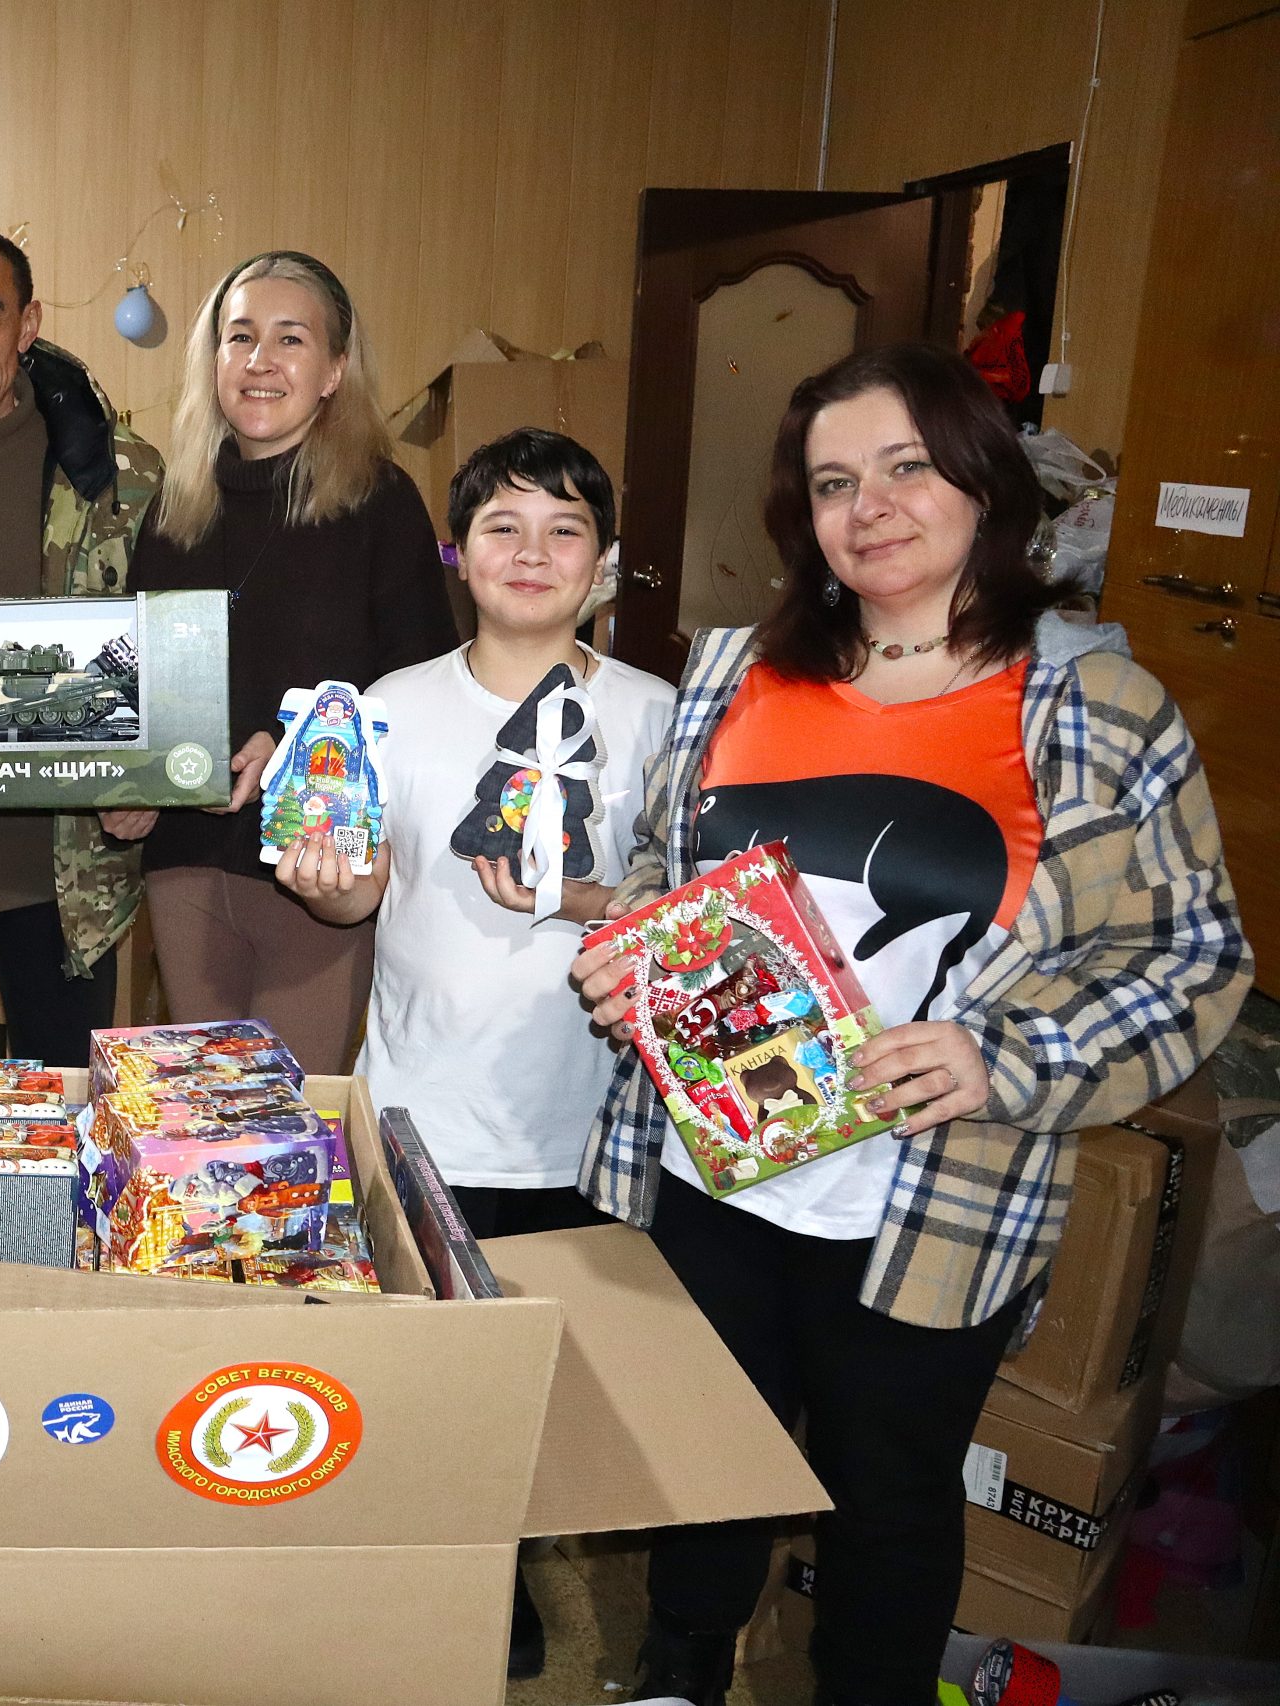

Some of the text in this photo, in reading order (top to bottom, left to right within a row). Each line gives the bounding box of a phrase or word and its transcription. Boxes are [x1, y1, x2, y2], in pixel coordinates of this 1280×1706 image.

[1160, 486, 1245, 522] Медикаменты
[173, 622, 201, 639] 3+
[173, 744, 205, 759] Одобрено
[38, 761, 125, 781] «ЩИТ»
[676, 999, 716, 1036] 35
[729, 1045, 787, 1076] КАНТАТА
[195, 1368, 349, 1413] СОВЕТ ВЕТЕРАНОВ
[60, 1404, 94, 1413] РОССИЯ
[166, 1430, 351, 1501] МИАССКОГО ГОРОДСКОГО ОКРУГА
[986, 1486, 997, 1508] 8743
[1009, 1489, 1025, 1520] ДЛЯ
